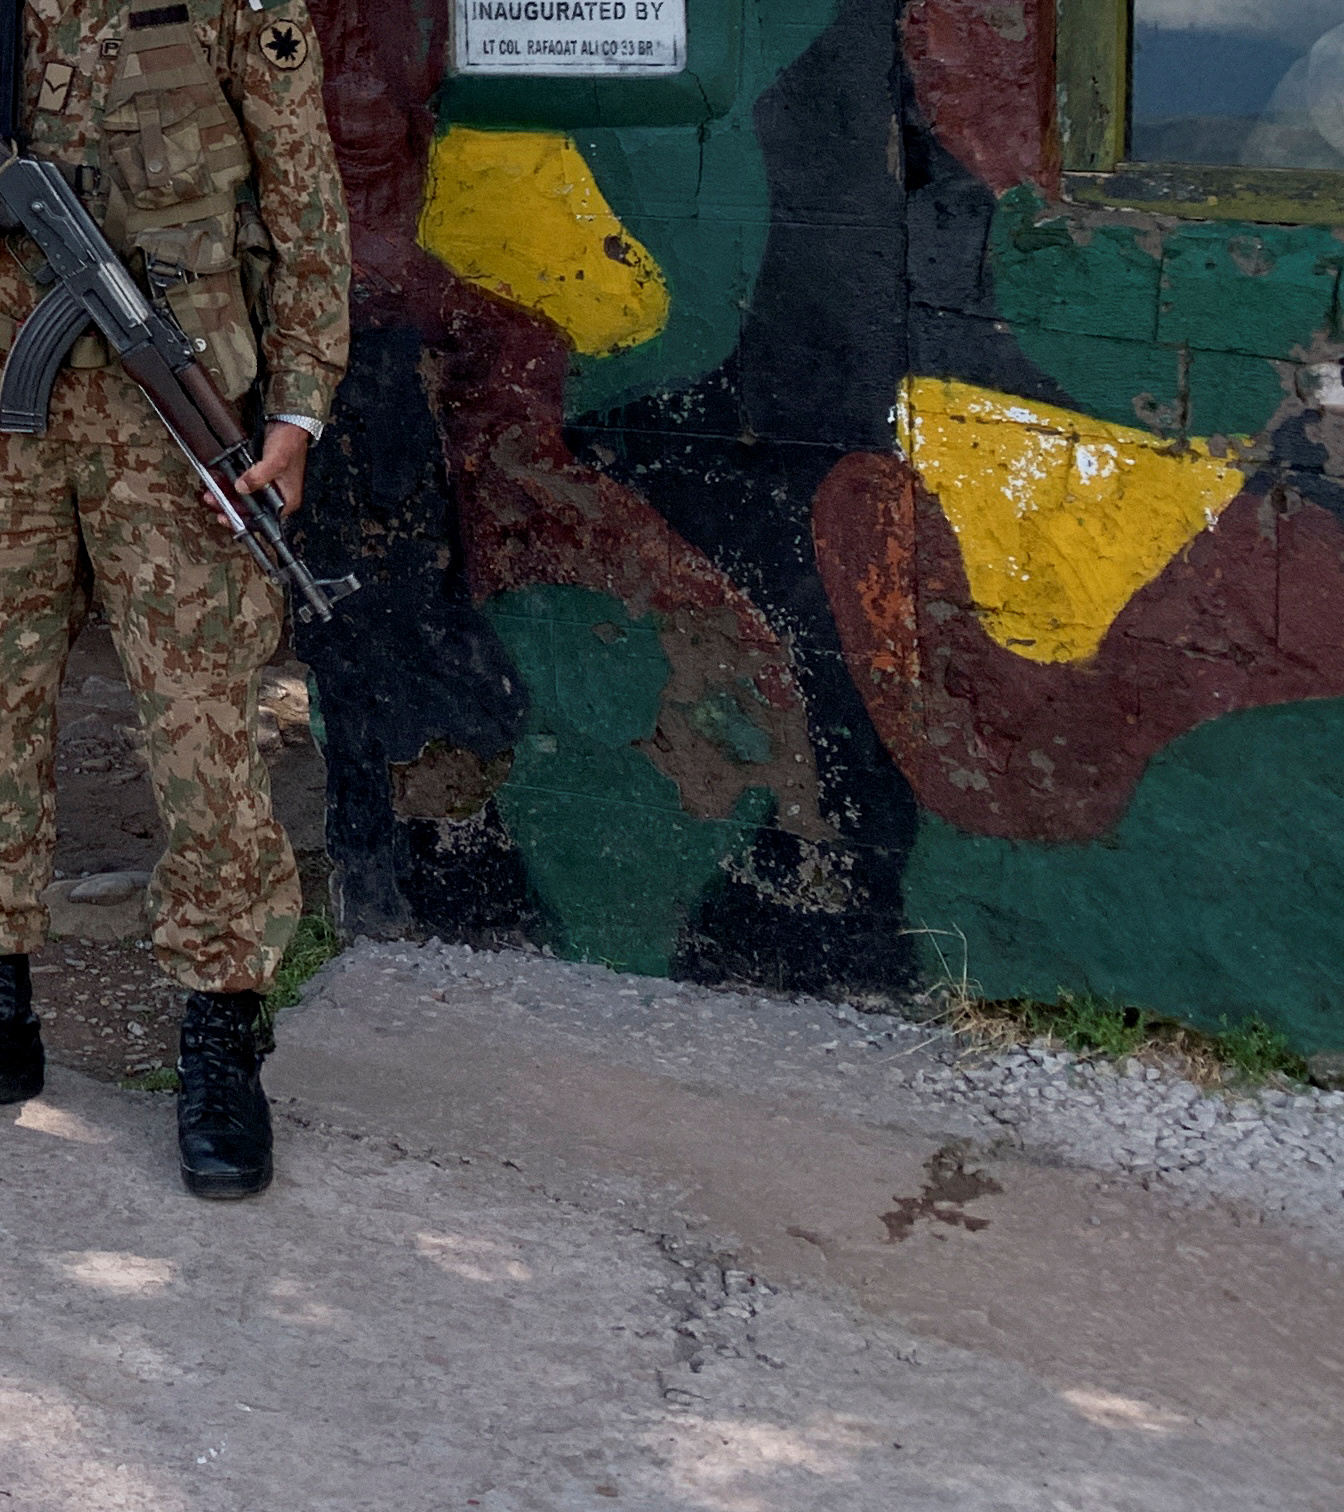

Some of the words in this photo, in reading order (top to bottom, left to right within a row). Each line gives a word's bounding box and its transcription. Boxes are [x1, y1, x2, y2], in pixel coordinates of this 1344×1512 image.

[472, 1, 626, 21] INAUGURATED
[635, 1, 664, 21] BY
[483, 39, 496, 55] LT
[498, 39, 521, 55] COL
[580, 39, 599, 55] ALI
